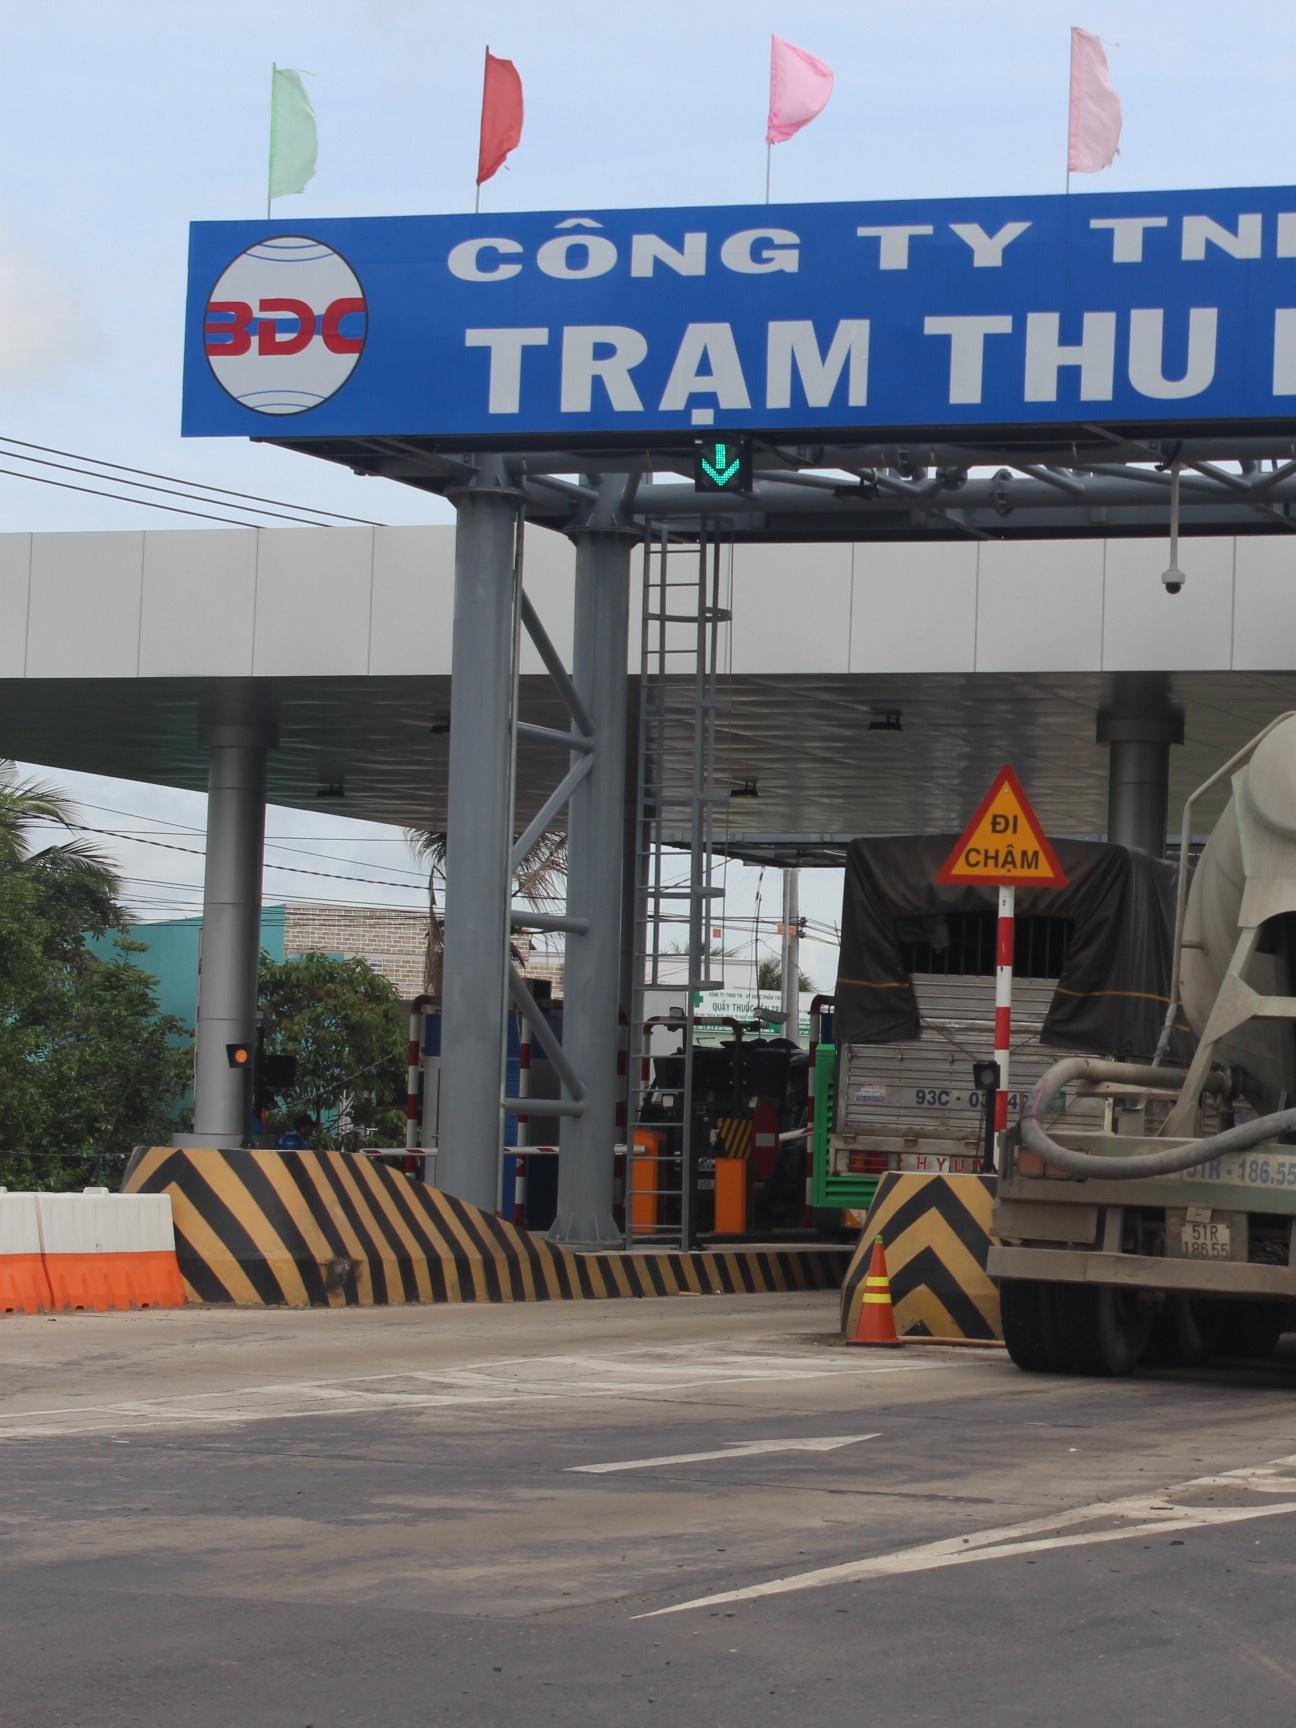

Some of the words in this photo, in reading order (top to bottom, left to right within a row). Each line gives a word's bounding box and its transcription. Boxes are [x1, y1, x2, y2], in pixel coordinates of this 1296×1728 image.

[448, 218, 800, 281] CÔNG
[857, 222, 1032, 269] TY
[466, 316, 869, 424] TRẠM
[924, 308, 1217, 403] THU
[991, 814, 1018, 834] ĐI
[964, 844, 1040, 872] CHẬM
[915, 1089, 950, 1106] 93C
[1192, 1224, 1218, 1241] 51R
